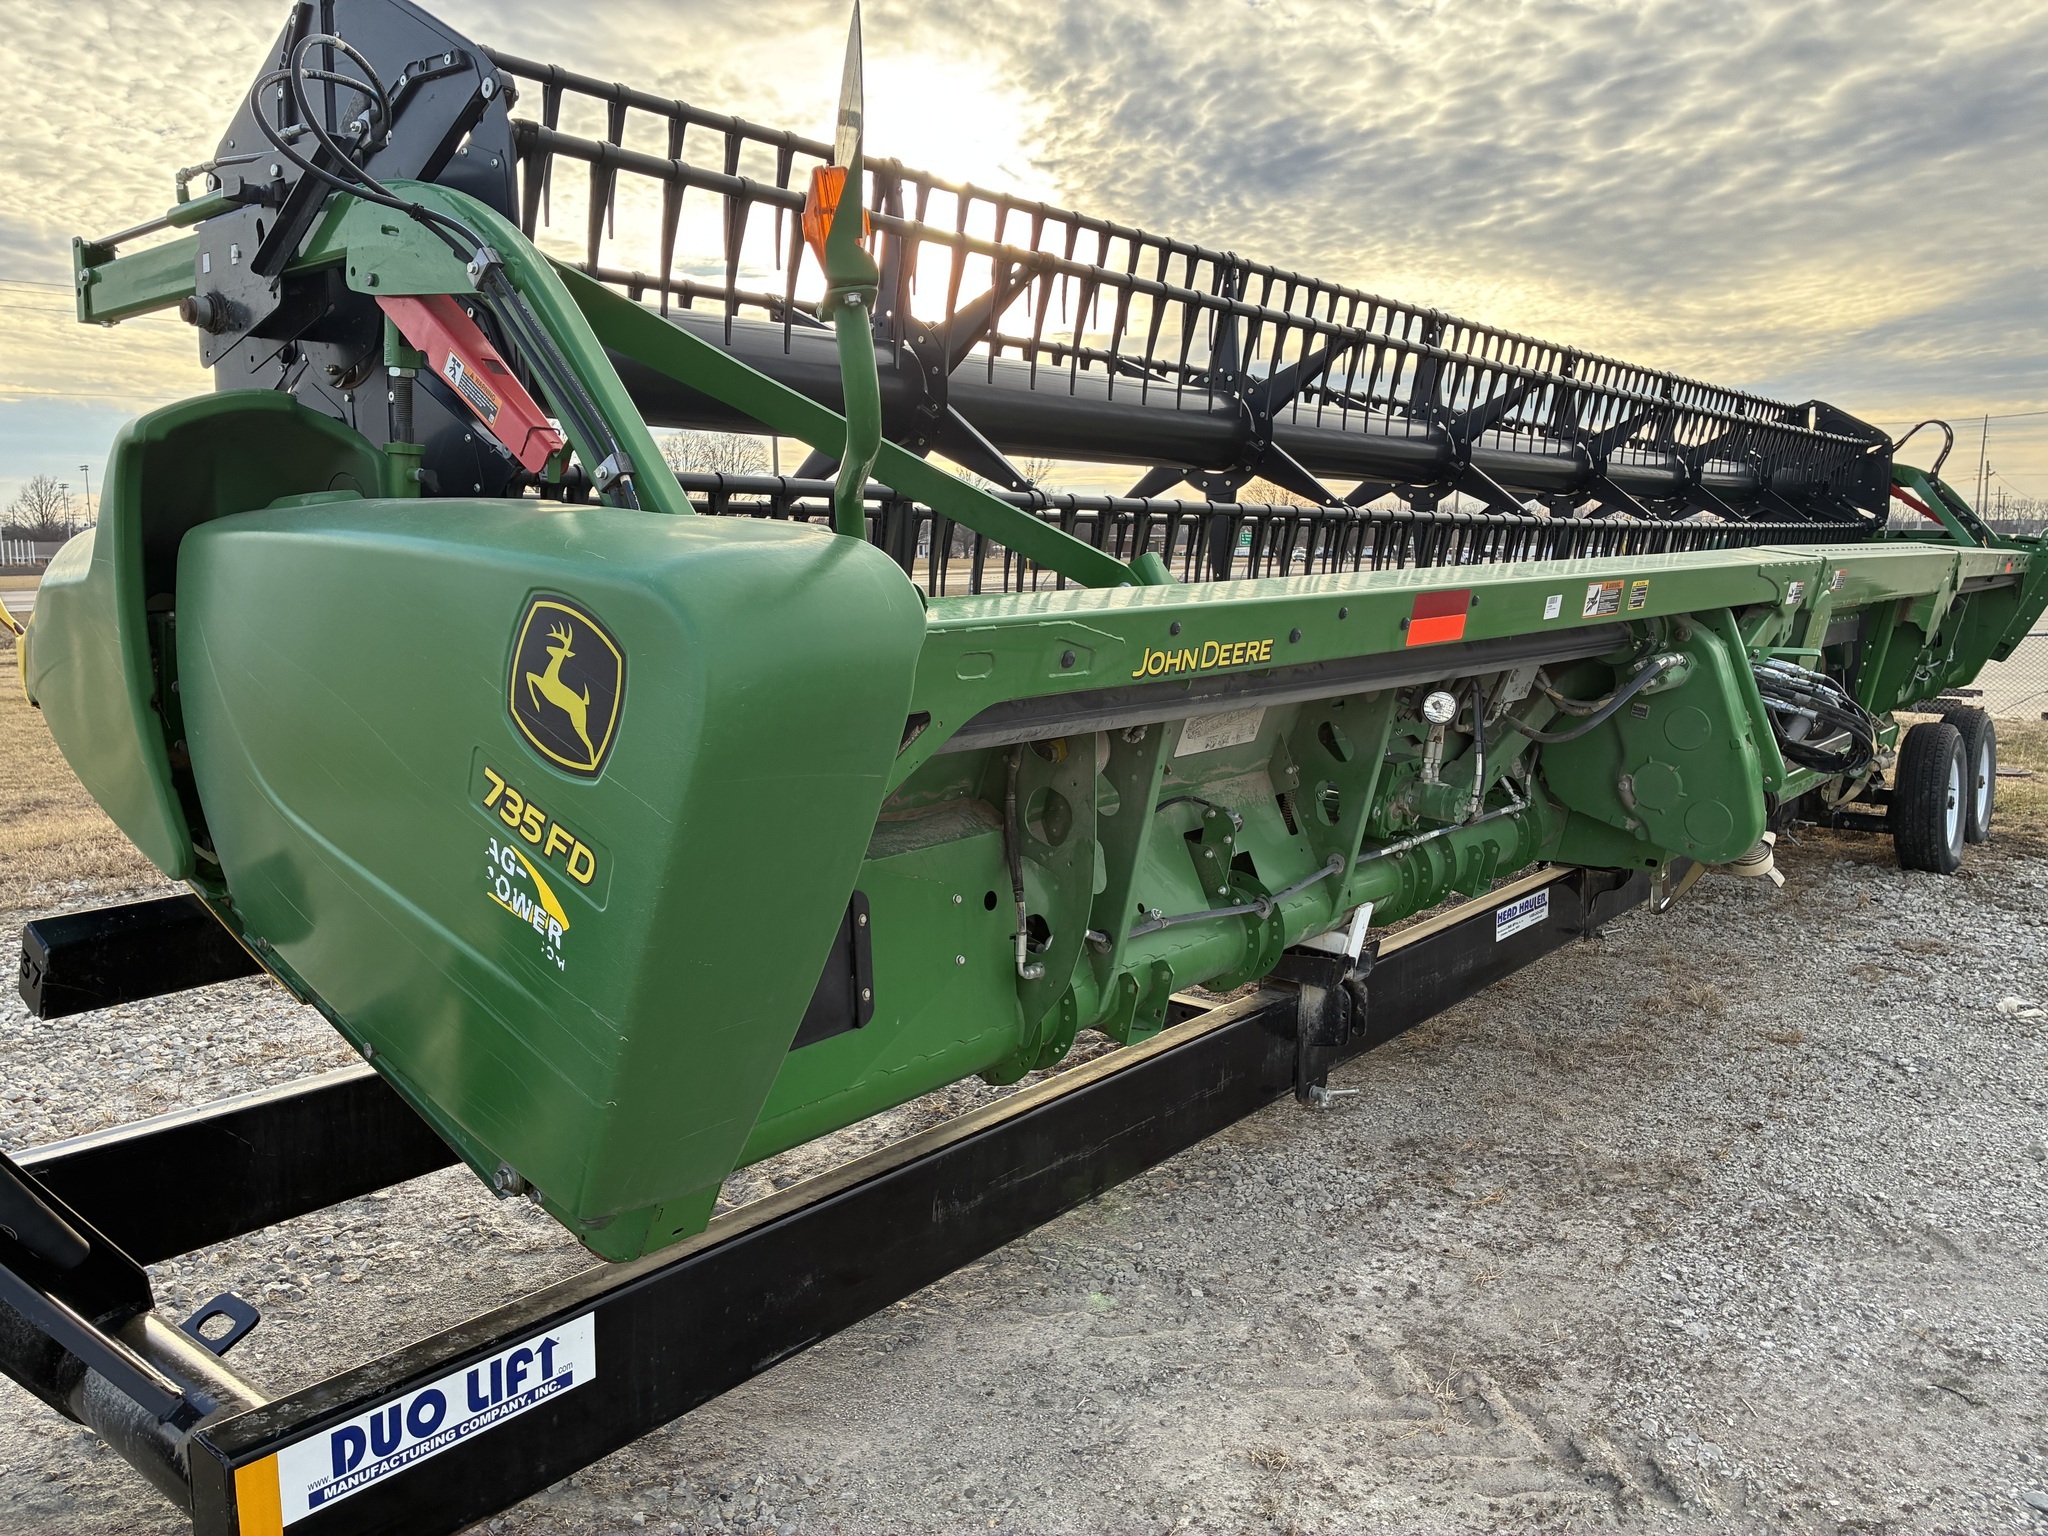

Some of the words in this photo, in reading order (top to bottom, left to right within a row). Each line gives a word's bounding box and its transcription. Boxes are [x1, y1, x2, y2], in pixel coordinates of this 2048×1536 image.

[475, 375, 496, 401] WARNING
[1131, 647, 1199, 677] JOHN
[1201, 639, 1274, 669] DEERE
[1497, 906, 1517, 923] HEAD
[1519, 893, 1546, 914] HAULER
[307, 1475, 331, 1491] www.
[331, 1388, 447, 1480] DUO
[467, 1337, 560, 1413] LIFT
[556, 1362, 573, 1375] .com
[324, 1430, 456, 1500] MANUFACTURING
[460, 1394, 531, 1435] COMPANY,
[535, 1381, 561, 1400] INC.
